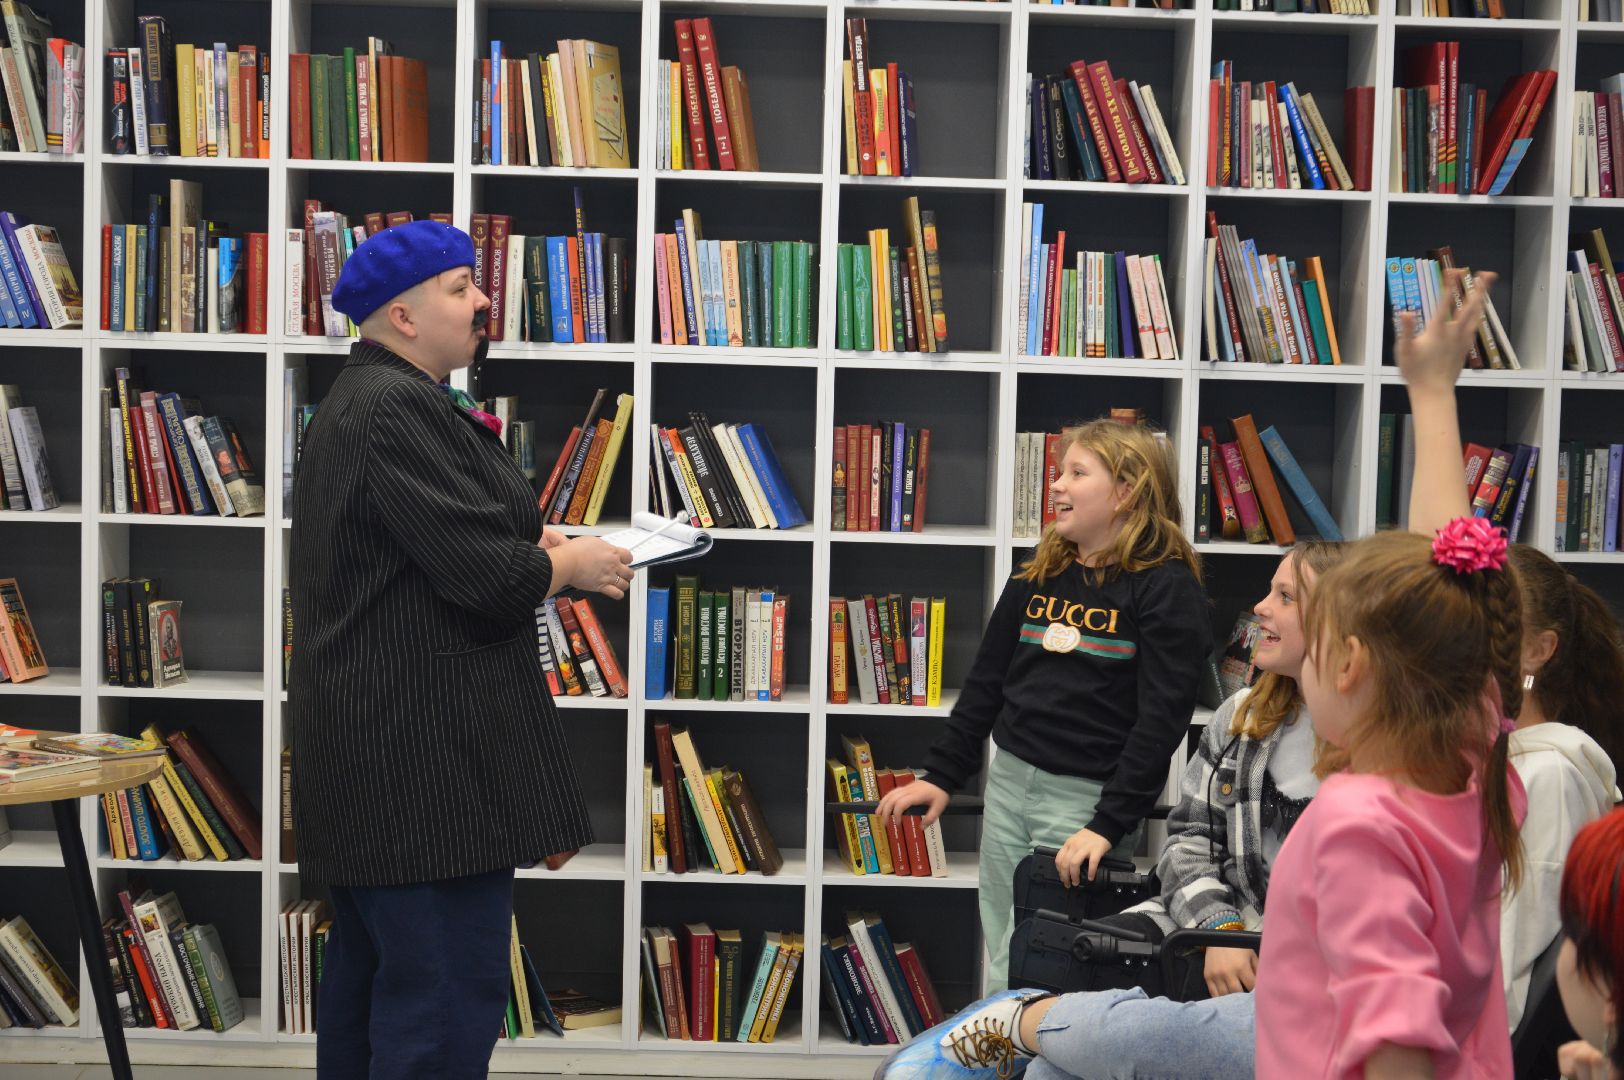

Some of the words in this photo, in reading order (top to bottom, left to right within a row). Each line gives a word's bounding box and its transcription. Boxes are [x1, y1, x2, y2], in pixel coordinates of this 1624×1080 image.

[855, 36, 863, 60] ВСЕГДА
[857, 61, 866, 91] ПОМНИТЬ
[1078, 78, 1090, 99] ВЕКА
[1100, 74, 1113, 97] ВЕКА
[358, 82, 368, 106] ЖУКОВ
[686, 64, 700, 125] ПОБЕДИТЕЛИ
[704, 63, 723, 124] ПОБЕДИТЕЛИ
[360, 108, 369, 138] МАРШАЛ
[1090, 116, 1110, 159] СОЛДАТЫ
[1113, 115, 1132, 157] СОЛДАТЫ
[1597, 105, 1609, 140] АЛЕКСЕЕВА
[1141, 146, 1158, 180] СОЛДАТЫ
[25, 228, 40, 261] МОСКВЫ
[577, 231, 587, 290] ВИДНОВСКОГО
[38, 261, 52, 290] ГОРОДА
[326, 247, 337, 279] МОСКВЫ
[474, 248, 483, 286] СОРОКОВ
[492, 249, 502, 287] СОРОКОВ
[7, 271, 26, 306] ИСТОРИЯ
[292, 263, 300, 299] МОСКВА
[1273, 271, 1285, 300] СУДЬБОЮ
[48, 289, 65, 324] ИСТОРИЯ
[292, 301, 300, 333] СТАРАЯ
[492, 290, 500, 319] СОРОК
[1280, 301, 1289, 317] СТАЛ
[1284, 319, 1293, 334] ЭТОТ
[1288, 336, 1298, 356] ГОРОД
[686, 435, 710, 478] ЭЙЗЕНХАУЭР
[700, 607, 710, 636] ВОСТОКА
[717, 606, 727, 635] ВОСТОКА
[1026, 594, 1120, 633] GUCCI
[700, 637, 710, 665] История
[716, 637, 727, 664] История
[733, 618, 742, 694] ВТОРЖЕНИЕ
[108, 792, 117, 824] Археоло
[740, 803, 758, 837] ПРОСТИТУЦИИ
[135, 816, 151, 845] ЗОЛОТО
[857, 816, 871, 838] ВЕСЬ
[754, 838, 766, 861] ИСТОРИЯ
[154, 952, 168, 977] НАРОД
[177, 943, 195, 981] ВОСТОЧНЫЕ
[186, 980, 205, 1010] СЛАВЯНЕ
[842, 953, 863, 996] ЭКОНОМИКА
[164, 979, 181, 1015] РУССКИЙ
[758, 968, 783, 1021] ЭКОНОМЕТРИКА
[771, 969, 794, 1022] ЭКОНОМЕТРИКА
